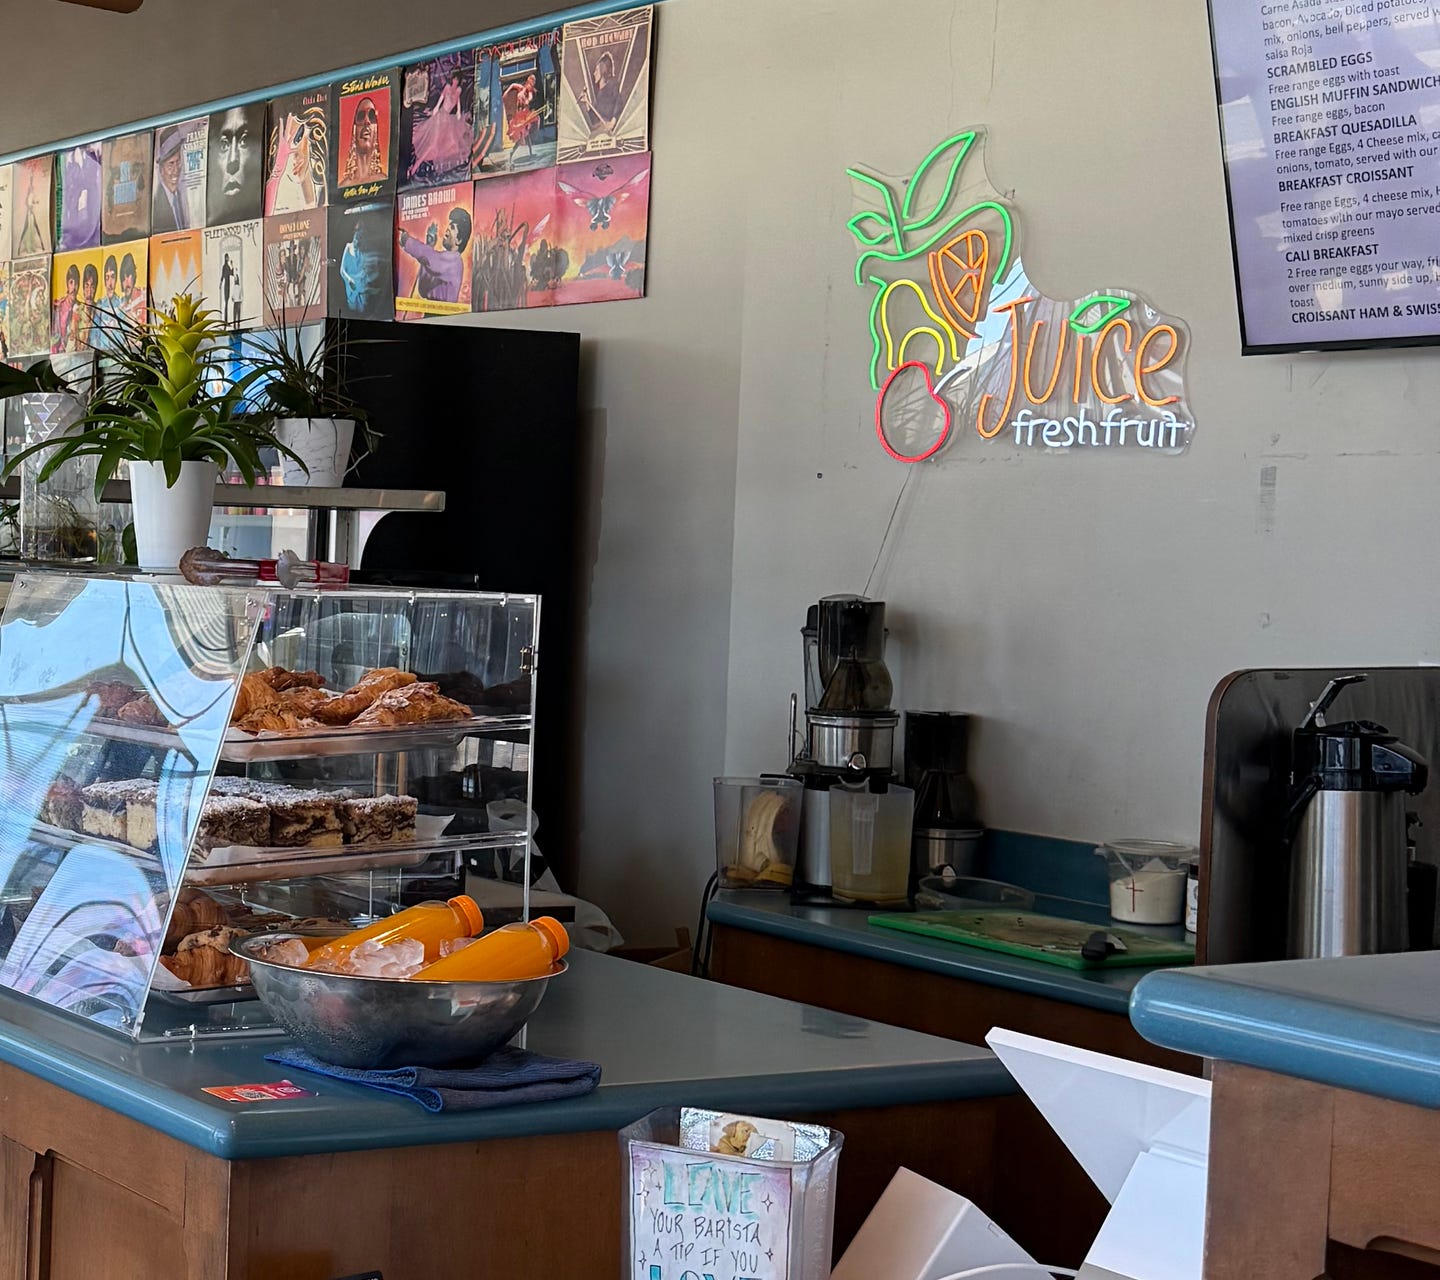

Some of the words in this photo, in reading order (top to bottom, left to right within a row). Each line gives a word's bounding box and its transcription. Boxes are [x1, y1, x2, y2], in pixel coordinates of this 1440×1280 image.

[1261, 4, 1289, 16] Carne
[1262, 18, 1294, 30] bacon,
[1345, 3, 1374, 16] Diced
[1264, 35, 1284, 47] mix,
[1287, 28, 1322, 43] onions,
[1325, 23, 1344, 35] bell
[1346, 15, 1392, 33] peppers,
[1394, 9, 1429, 25] served
[1265, 50, 1288, 60] salsa
[1291, 46, 1312, 58] Roja
[1267, 57, 1337, 78] SCRAMBLED
[1341, 52, 1372, 67] EGGS
[1268, 83, 1290, 94] Free
[1292, 78, 1320, 92] range
[1322, 76, 1346, 89] eggs
[1348, 69, 1370, 82] with
[1373, 66, 1400, 79] toast
[1270, 94, 1319, 111] ENGLISH
[1322, 84, 1369, 103] MUFFIN
[1373, 76, 1440, 95] SANDWICH
[1272, 115, 1292, 126] Free
[1295, 111, 1322, 125] range
[1325, 106, 1352, 121] eggs,
[1354, 101, 1385, 114] bacon
[1274, 125, 1338, 144] BREAKFAST
[1341, 114, 1416, 136] QUESADILLA
[1275, 148, 1296, 160] Free
[1299, 144, 1326, 158] range
[1329, 141, 1355, 156] Eggs,
[1358, 138, 1364, 148] 4
[1366, 136, 1404, 148] Cheese
[1407, 132, 1430, 144] mix,
[1277, 162, 1312, 174] onions,
[1314, 157, 1354, 170] tomato,
[1356, 151, 1390, 165] served
[1393, 148, 1416, 160] with
[1419, 147, 1438, 156] our
[1278, 174, 1343, 192] BREAKFAST
[1346, 166, 1414, 184] CROISSANT
[403, 194, 427, 210] JAMES
[427, 188, 456, 206] BROWN
[1280, 200, 1302, 212] Free
[1304, 198, 1332, 211] range
[1334, 194, 1360, 209] Eggs,
[1363, 193, 1369, 202] 4
[1372, 189, 1408, 201] cheese
[1411, 186, 1433, 199] mix,
[1282, 216, 1328, 228] tomatoes
[1330, 211, 1353, 224] with
[1356, 210, 1373, 221] our
[1376, 207, 1404, 221] mayo
[1406, 202, 1440, 216] served
[1284, 230, 1312, 243] mixed
[1315, 228, 1338, 242] crisp
[1341, 226, 1374, 239] greens
[1286, 250, 1310, 262] CALI
[1313, 244, 1379, 260] BREAKFAST
[1288, 269, 1293, 278] 2
[1296, 266, 1317, 278] Free
[1320, 263, 1348, 278] range
[1350, 262, 1373, 276] eggs
[1376, 260, 1399, 272] your
[1402, 258, 1424, 270] way,
[1289, 282, 1310, 293] over
[1359, 276, 1389, 290] sunny
[1392, 272, 1412, 285] side
[1416, 274, 1432, 285] up,
[1290, 297, 1314, 308] toast
[1292, 308, 1356, 323] CROISSANT
[1359, 304, 1389, 319] HAM
[1393, 304, 1403, 317] &
[977, 297, 1181, 438] Juice
[662, 1159, 763, 1216] LEAVE
[650, 1208, 683, 1236] YOUR
[694, 1216, 762, 1248] BARISTA
[652, 1238, 663, 1258] A
[670, 1243, 695, 1263] TIP
[701, 1248, 721, 1266] IF
[730, 1250, 759, 1274] YOU
